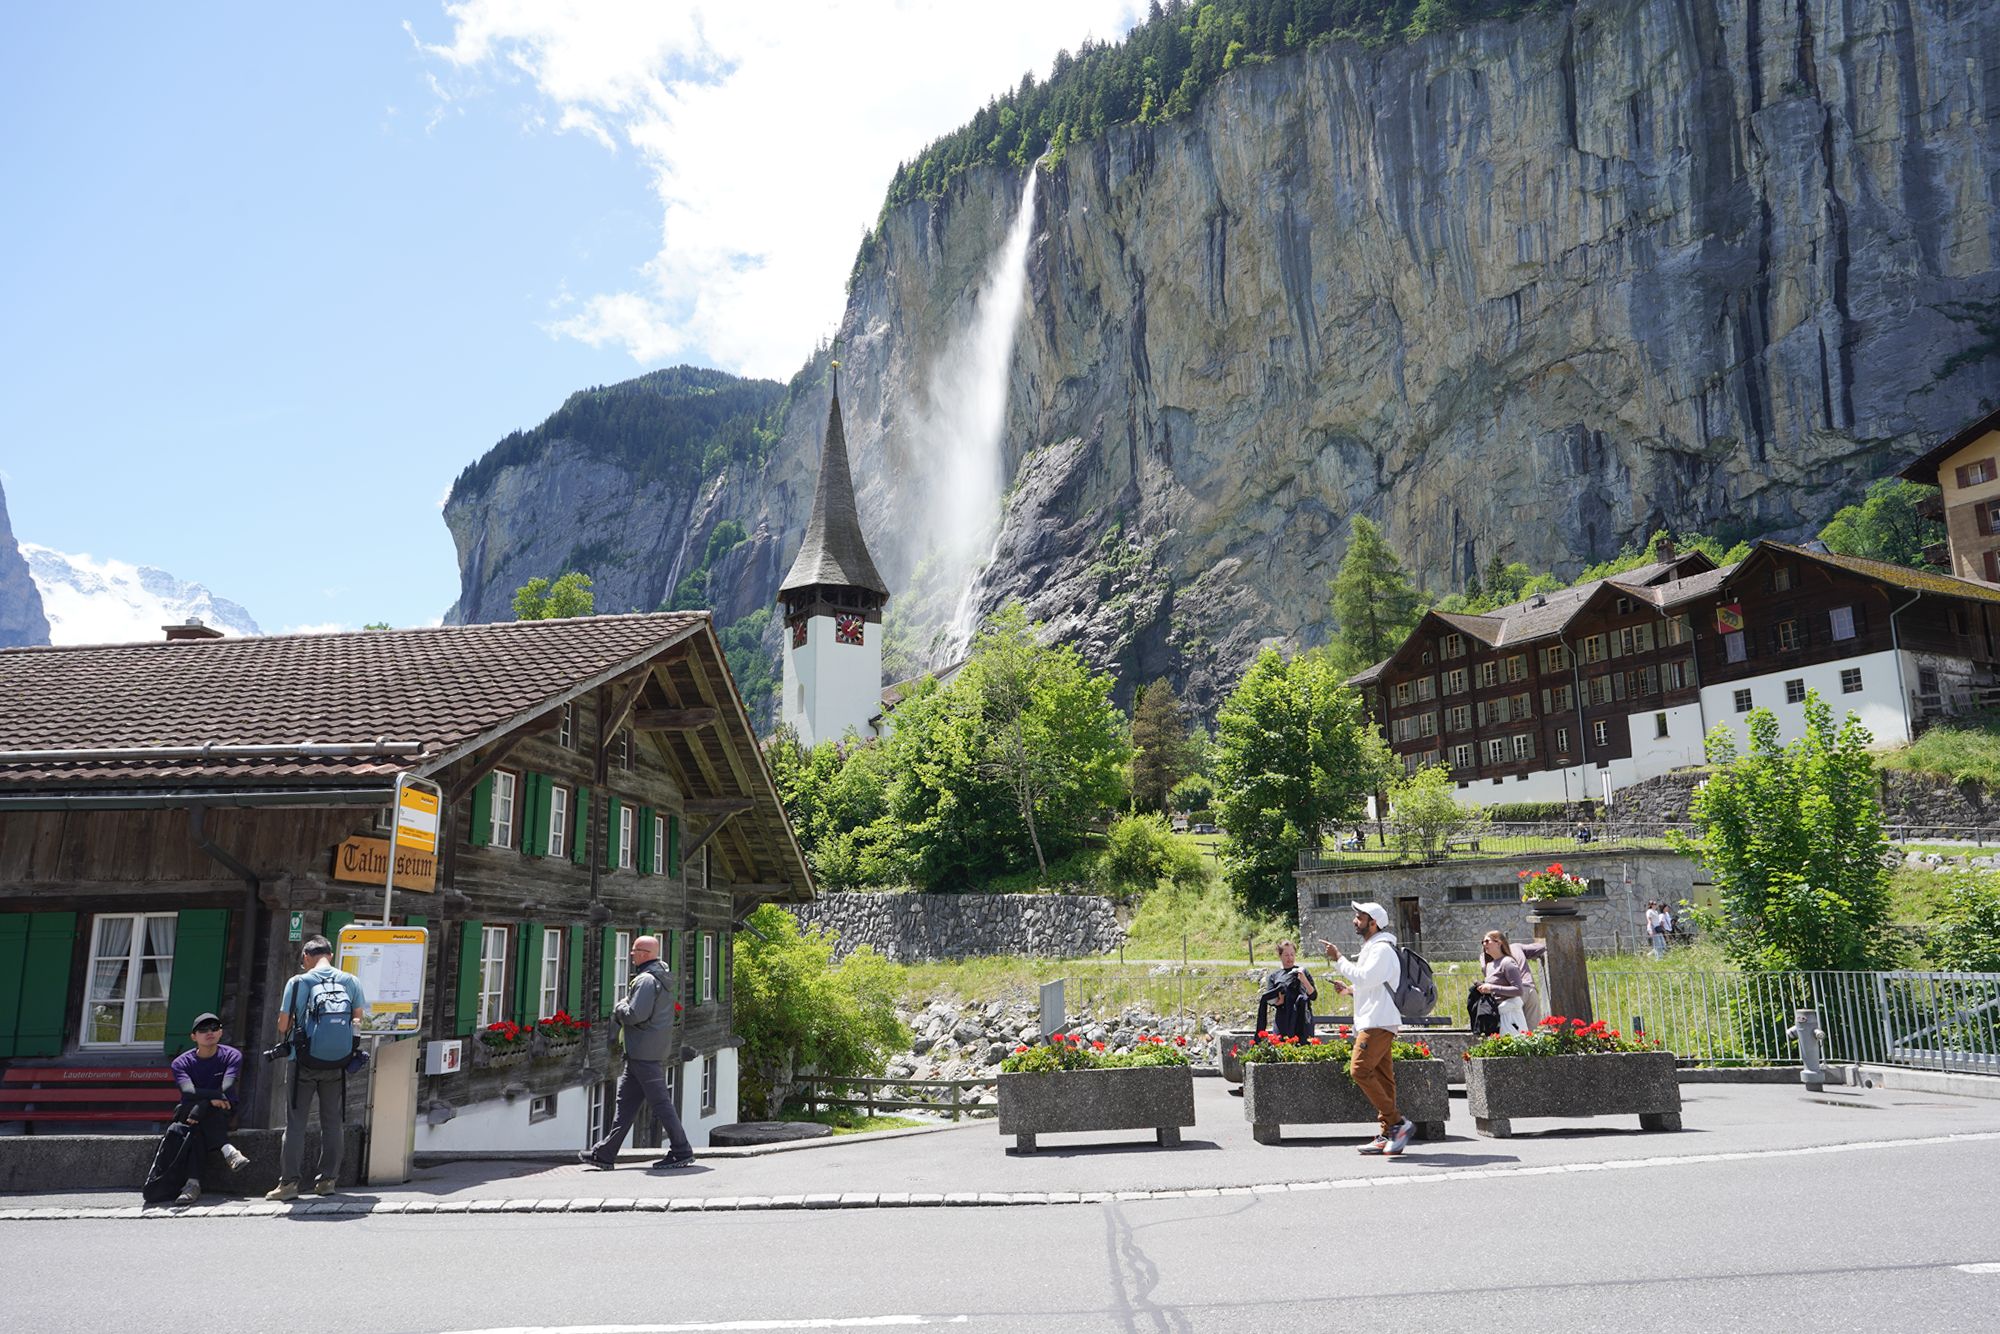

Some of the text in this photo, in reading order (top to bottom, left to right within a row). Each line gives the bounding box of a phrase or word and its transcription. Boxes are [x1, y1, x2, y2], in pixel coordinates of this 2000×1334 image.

[343, 843, 433, 877] Talmseum
[63, 1070, 169, 1079] Lauterbrunnen Tourismus
